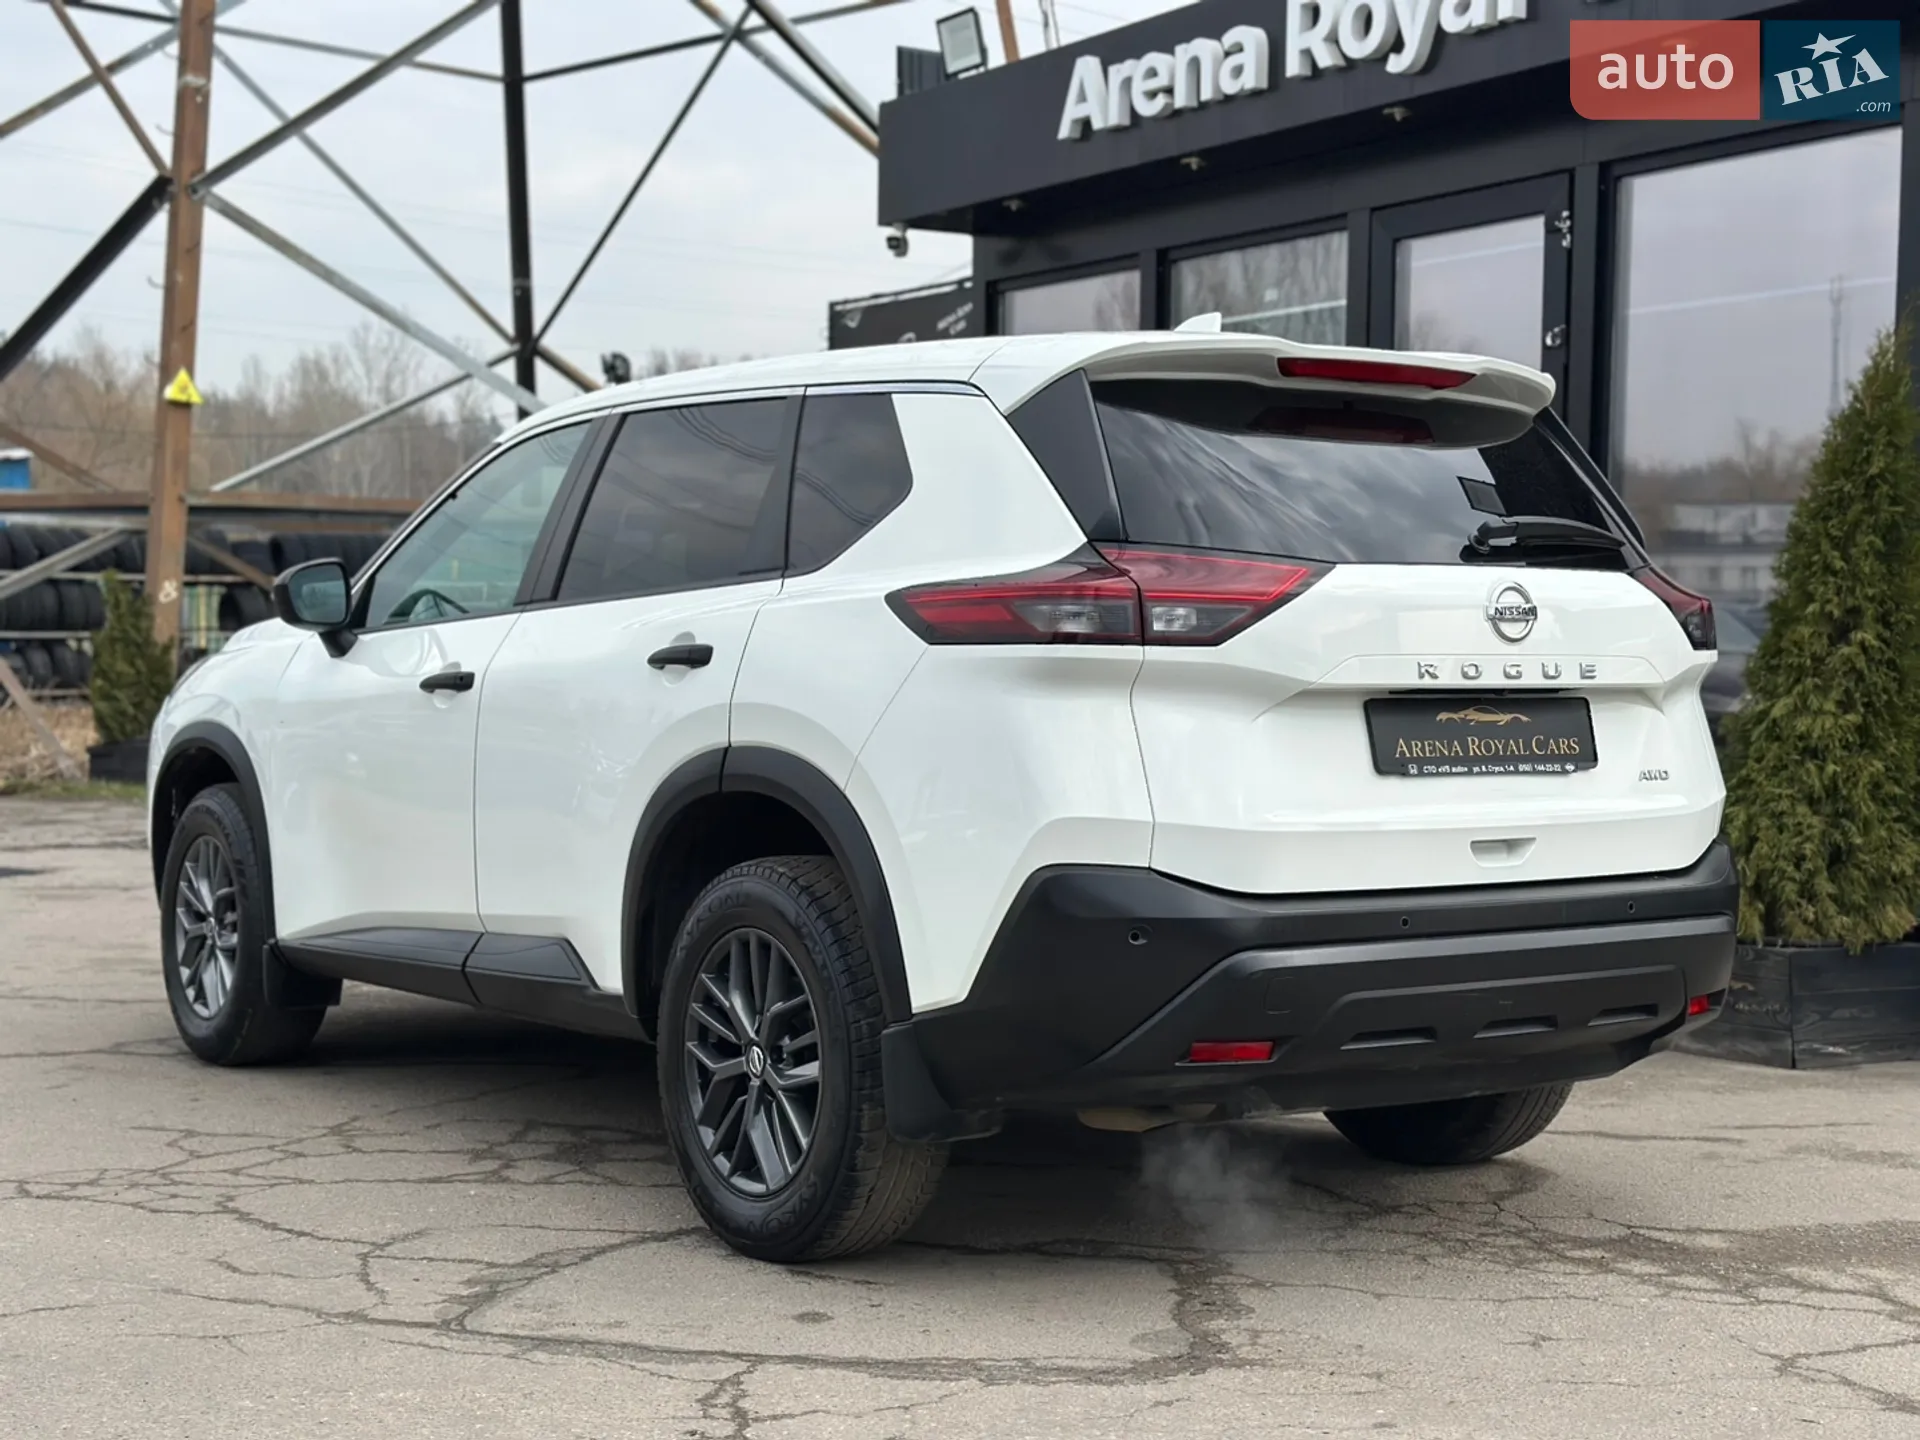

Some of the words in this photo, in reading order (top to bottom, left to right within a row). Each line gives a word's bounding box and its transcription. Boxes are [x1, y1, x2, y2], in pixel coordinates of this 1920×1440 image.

[1057, 25, 1269, 140] Arena
[1494, 605, 1537, 617] NISSAN
[1417, 661, 1597, 681] ROGUE
[1395, 737, 1464, 758] ARENA
[1467, 736, 1530, 756] ROYAL
[1532, 734, 1580, 755] CARS
[1638, 769, 1669, 781] AWD
